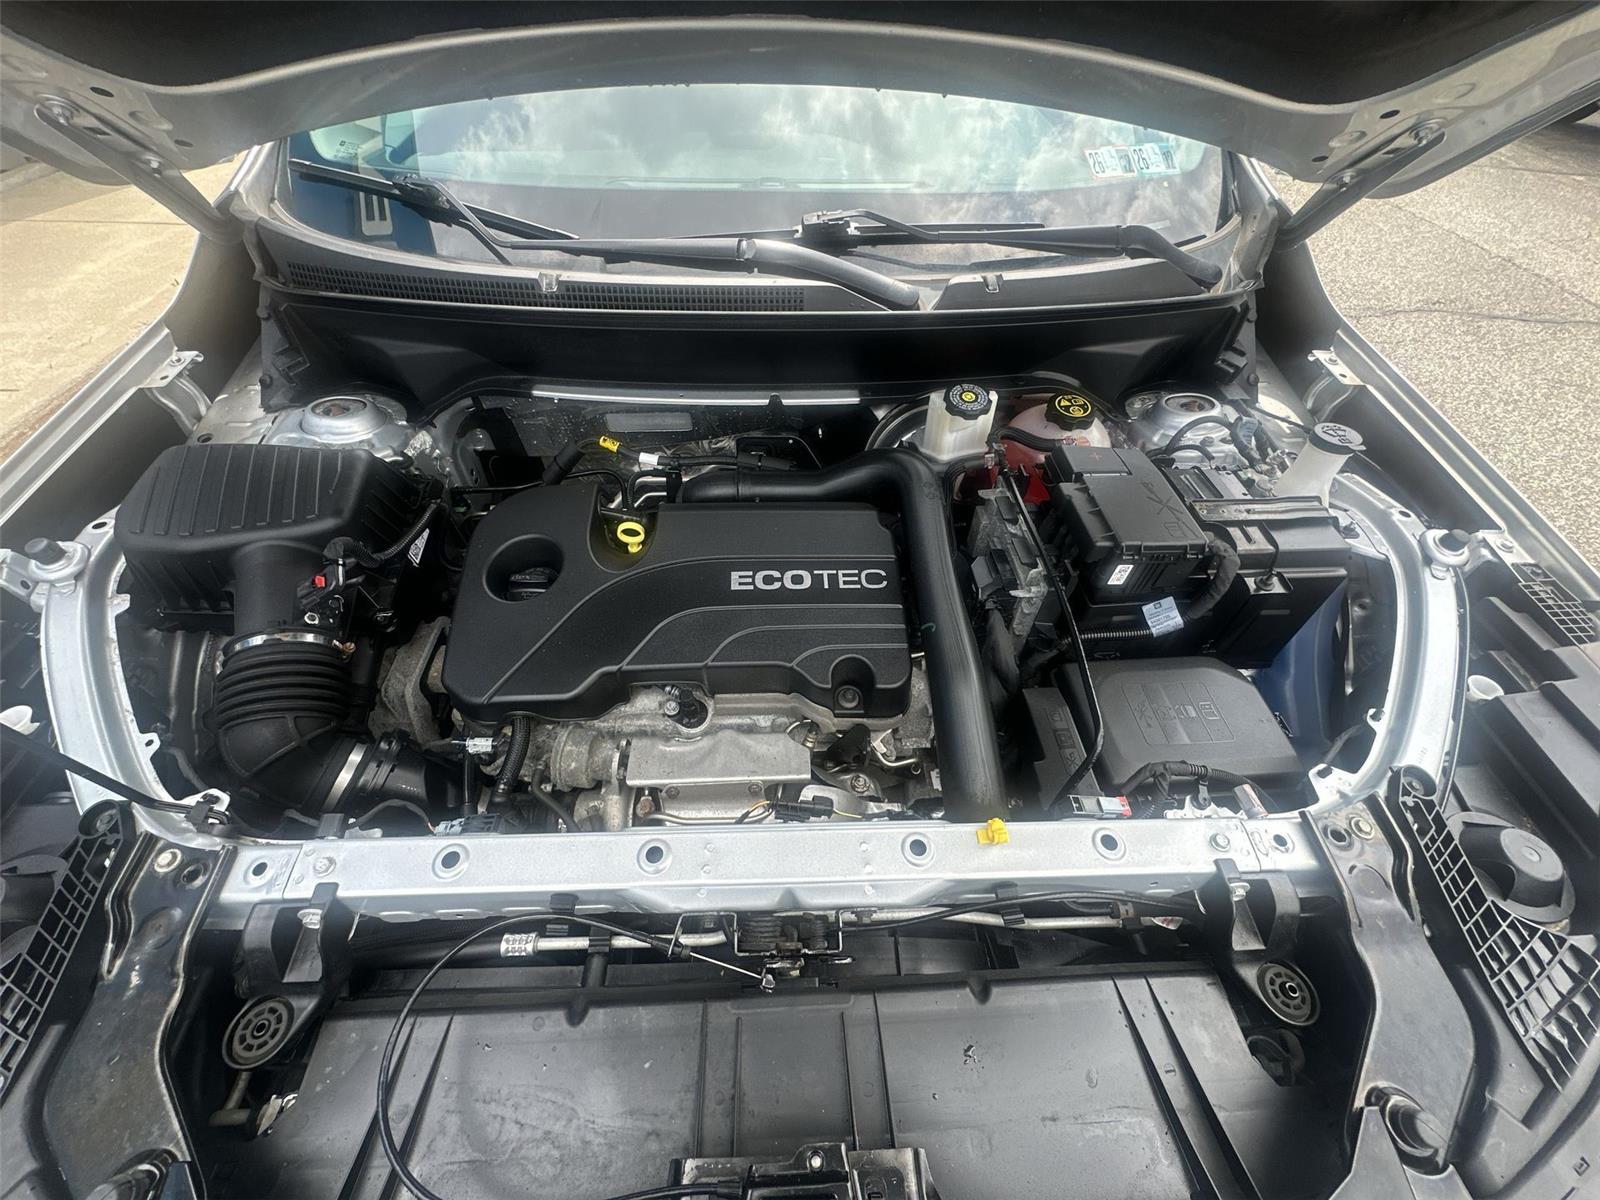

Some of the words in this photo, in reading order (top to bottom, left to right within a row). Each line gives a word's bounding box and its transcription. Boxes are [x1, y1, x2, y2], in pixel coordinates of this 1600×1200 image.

[1088, 152, 1105, 174] 26
[1133, 148, 1149, 170] 26
[730, 569, 888, 590] ECOTEC
